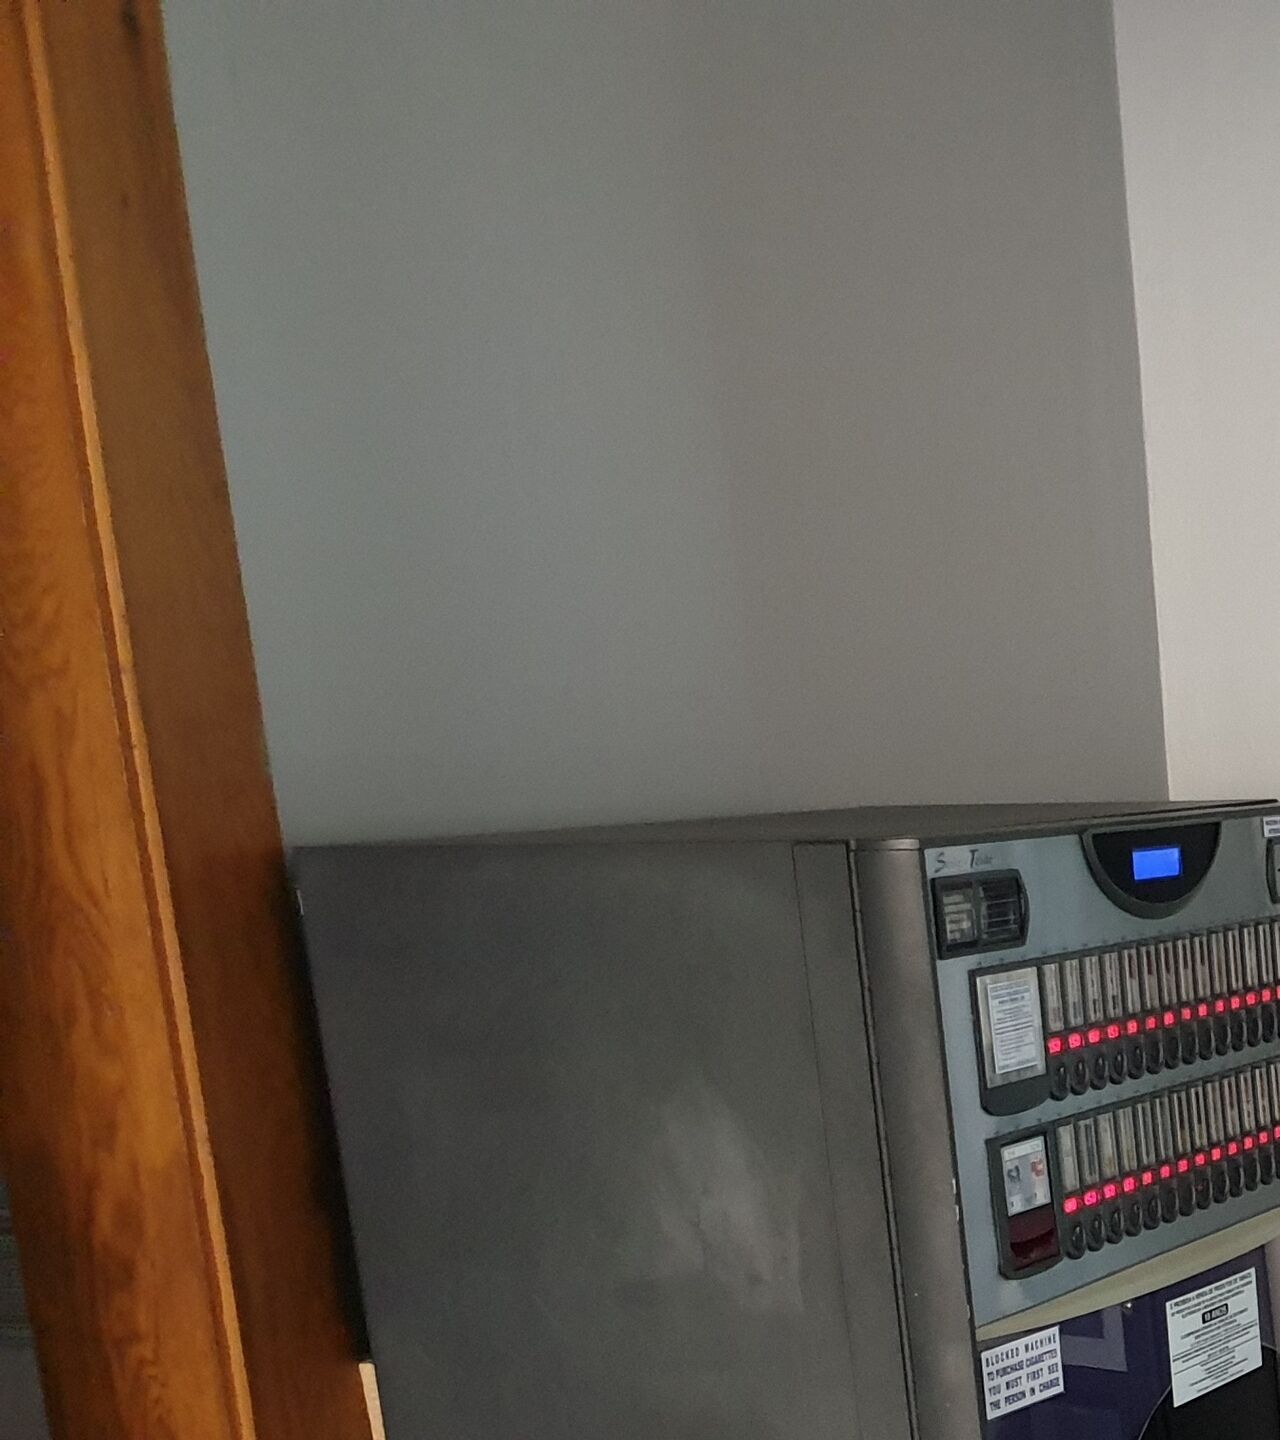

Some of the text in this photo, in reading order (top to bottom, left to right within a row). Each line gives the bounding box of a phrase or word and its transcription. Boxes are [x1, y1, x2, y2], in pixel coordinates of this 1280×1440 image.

[985, 1333, 1057, 1368] BLOCKED MACHINE
[987, 1348, 1058, 1381] TO PURCHASE CIGARETTES
[988, 1363, 1059, 1397] YOU MUST FIRST SEE
[989, 1377, 1061, 1412] THE PERSON IN CHARGE
